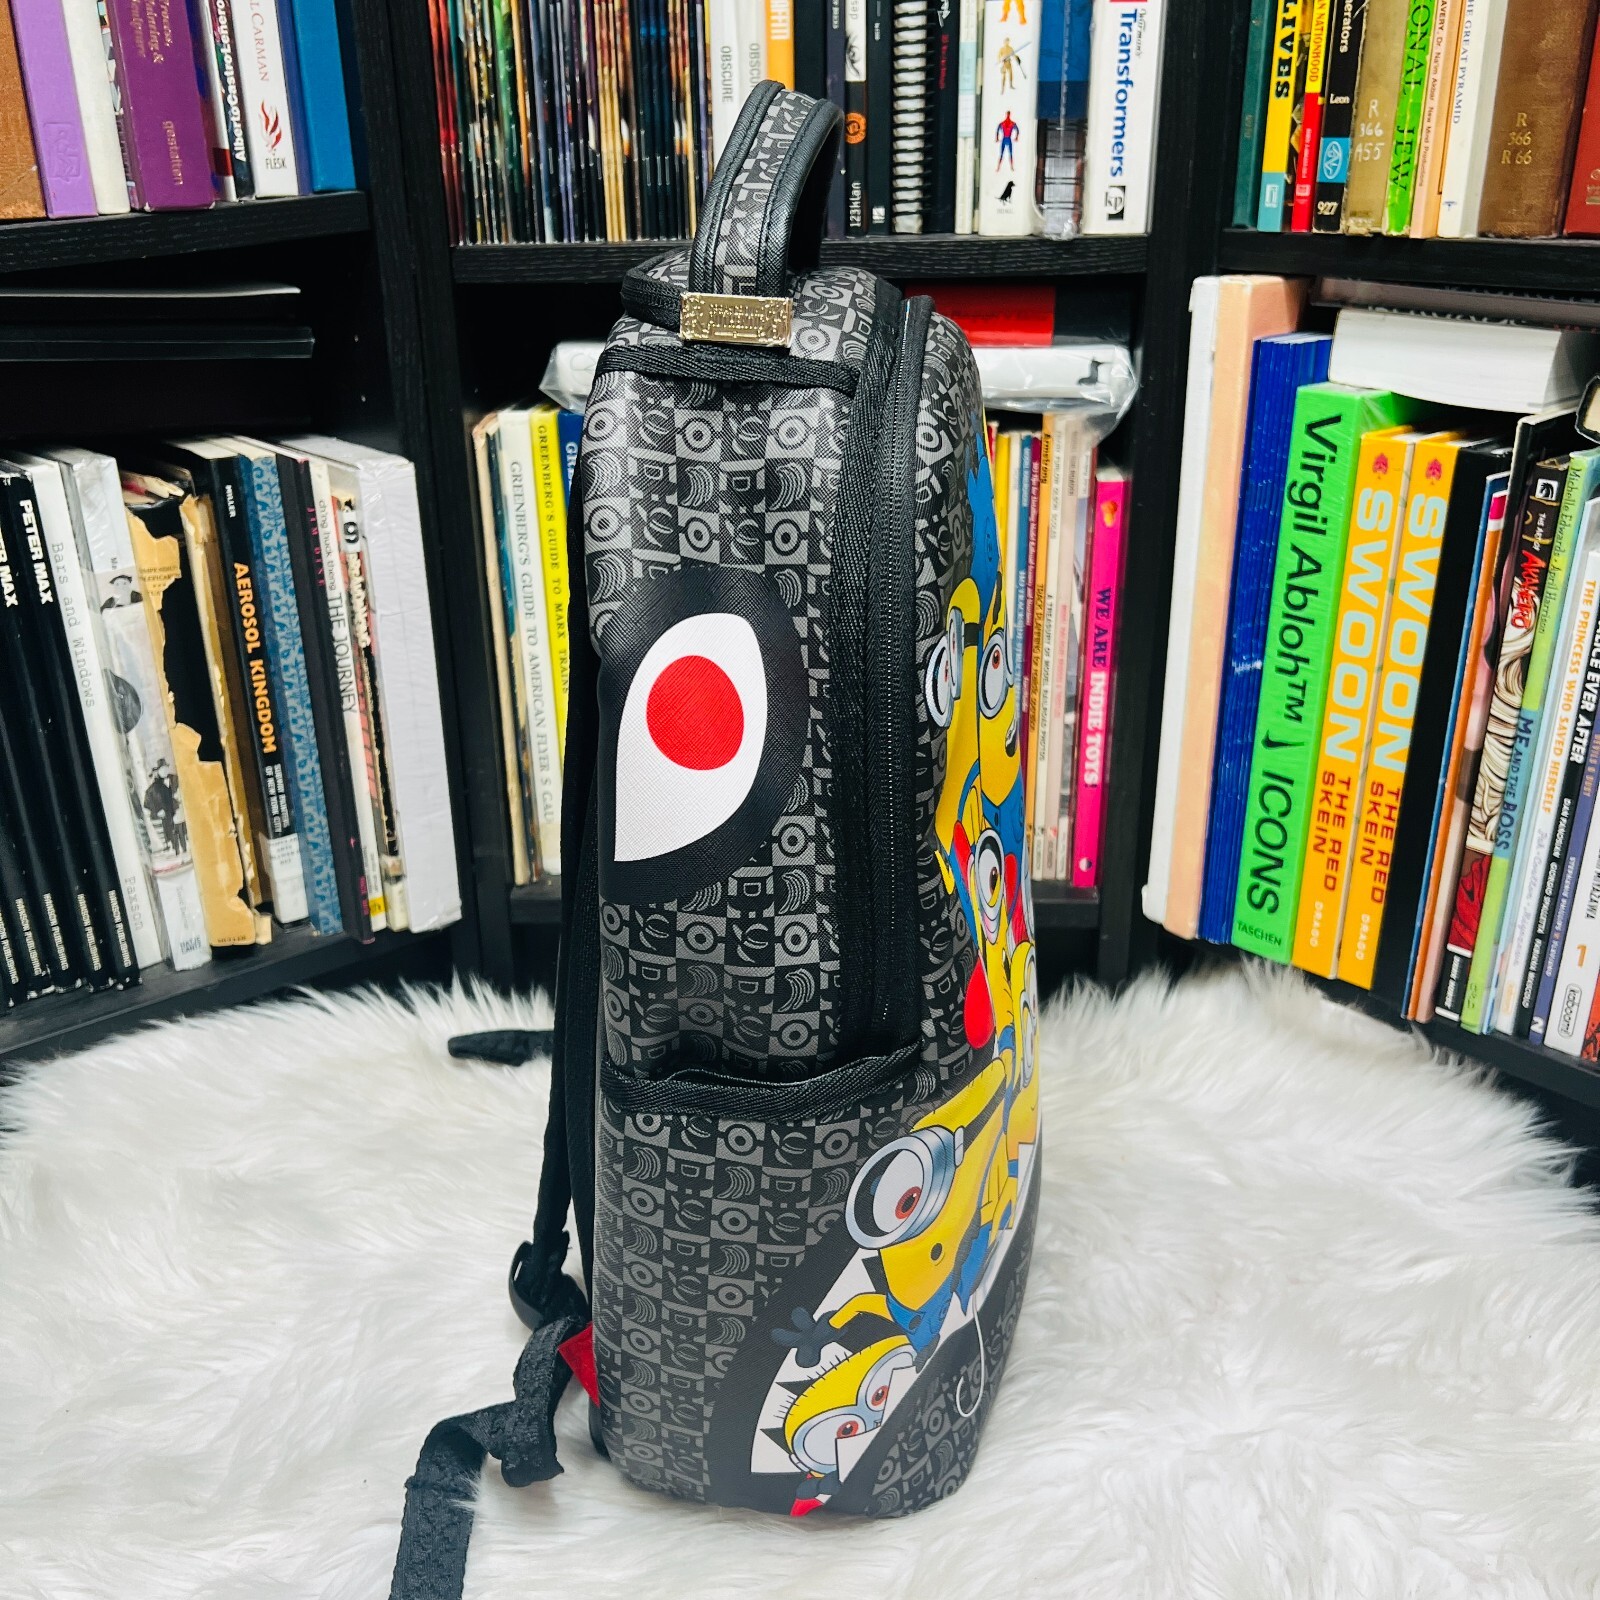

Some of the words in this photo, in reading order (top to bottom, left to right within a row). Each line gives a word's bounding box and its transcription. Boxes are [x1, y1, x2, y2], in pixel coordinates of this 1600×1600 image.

[252, 13, 270, 82] CARMAN
[749, 42, 761, 88] OBSCU
[1309, 12, 1325, 83] NATIONHOOD
[1400, 0, 1432, 96] ONAL
[1460, 20, 1473, 64] GREAT
[720, 45, 734, 103] OBSCURE
[1110, 8, 1138, 178] Transformers
[1452, 66, 1468, 125] PYRAMID
[1368, 99, 1380, 119] R
[1516, 112, 1528, 128] R
[162, 120, 184, 186] gestalten
[1388, 124, 1416, 192] JEW
[1501, 149, 1513, 165] R
[1514, 149, 1533, 166] 66
[1508, 130, 1532, 147] 366
[265, 158, 288, 170] FLESK
[537, 425, 555, 522] GREENBERG'S
[1038, 433, 1054, 485] Armstrong
[1286, 414, 1343, 537] Virgil
[224, 484, 237, 518] MILLER
[1562, 466, 1582, 512] Michelle
[510, 460, 530, 566] GREENBERG'S
[1553, 513, 1572, 558] Edwards
[20, 499, 44, 560] PETER
[33, 561, 54, 605] MAX
[546, 528, 561, 570] GUIDE
[518, 572, 538, 620] GUIDE
[551, 577, 563, 595] TO
[1034, 583, 1047, 611] TRACK
[1545, 565, 1562, 590] April
[1582, 580, 1597, 606] THE
[51, 542, 68, 584] Bars
[63, 597, 79, 628] and
[71, 636, 96, 711] Windows
[327, 592, 347, 629] THE
[552, 603, 567, 639] MARX
[1042, 602, 1057, 645] TREASURY
[1095, 586, 1113, 621] WE
[1324, 486, 1394, 762] SWOON
[1538, 590, 1556, 635] Harrison
[525, 626, 538, 647] TO
[1091, 625, 1110, 668] ARE
[1372, 492, 1449, 774] SWOON
[1569, 611, 1591, 675] PRINCESS
[233, 561, 254, 655] AEROSOL
[250, 658, 277, 755] KINGDOM
[333, 637, 358, 715] JOURNEY
[556, 649, 573, 694] TRAINS
[1041, 660, 1052, 687] MODEL
[527, 652, 547, 729] AMERICAN
[1038, 689, 1051, 729] RAILROAD
[1086, 671, 1108, 731] INDIE
[1561, 679, 1577, 713] WHO
[1580, 671, 1600, 714] EVER
[1037, 731, 1049, 761] PHOTOS
[1514, 716, 1534, 748] ME
[1553, 716, 1569, 757] SAVED
[1570, 713, 1593, 764] AFTER
[1510, 751, 1523, 773] AND
[270, 796, 279, 815] YORK
[1333, 775, 1352, 831] THE
[1505, 773, 1519, 799] THE
[1542, 760, 1561, 814] HERSELF
[1562, 797, 1572, 818] DAN
[1312, 771, 1337, 854] SKEIN
[1359, 780, 1386, 867] SKEIN
[1383, 787, 1400, 841] THE
[1496, 800, 1518, 850] BOSS
[1247, 769, 1295, 915] ICONS
[1323, 839, 1342, 892] RED
[1371, 849, 1392, 905] RED
[124, 875, 145, 931] Paxson
[1309, 900, 1324, 949] DRAGO
[1236, 921, 1283, 948] TASCHEN
[1356, 913, 1371, 962] DRAGO
[1576, 943, 1588, 969] 1
[1530, 1016, 1544, 1035] 2
